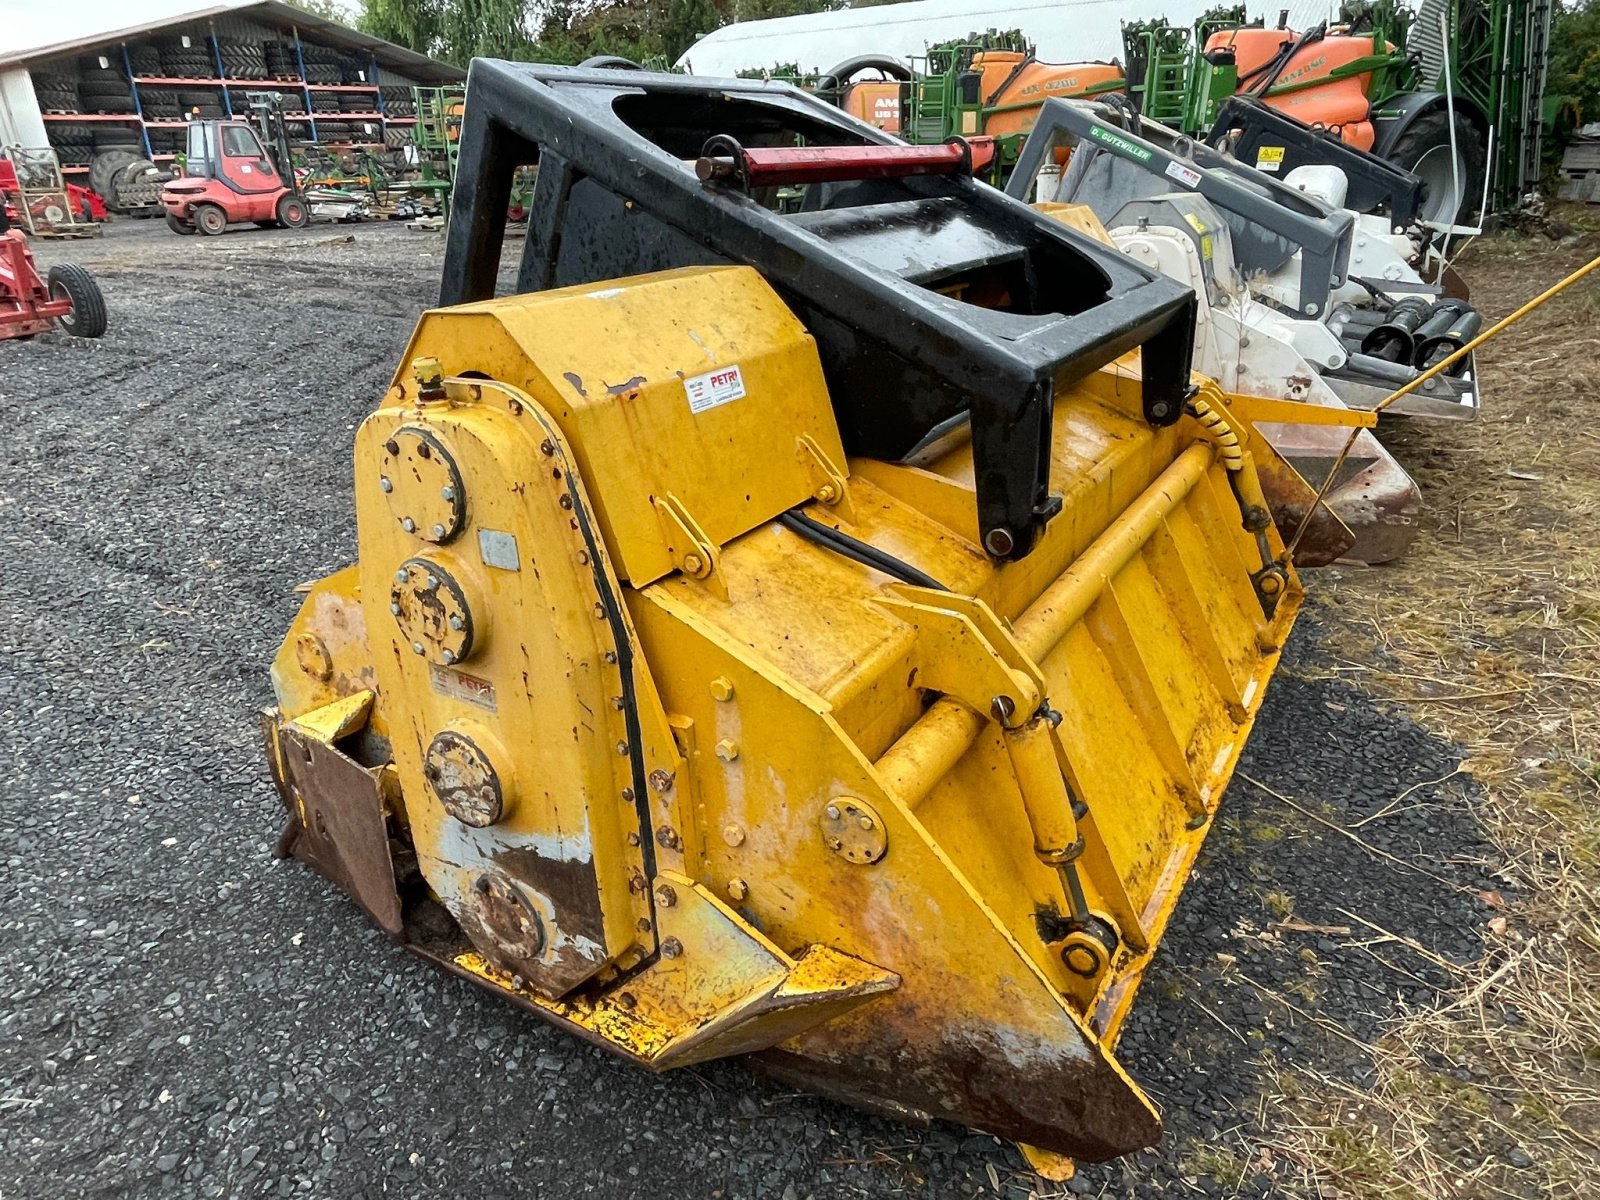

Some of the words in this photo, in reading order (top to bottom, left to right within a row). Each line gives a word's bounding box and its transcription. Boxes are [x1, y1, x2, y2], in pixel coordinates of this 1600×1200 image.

[1044, 78, 1078, 91] 4200
[1091, 128, 1099, 137] D.
[1101, 133, 1149, 160] GUTZWILLER
[710, 370, 738, 388] PETRI
